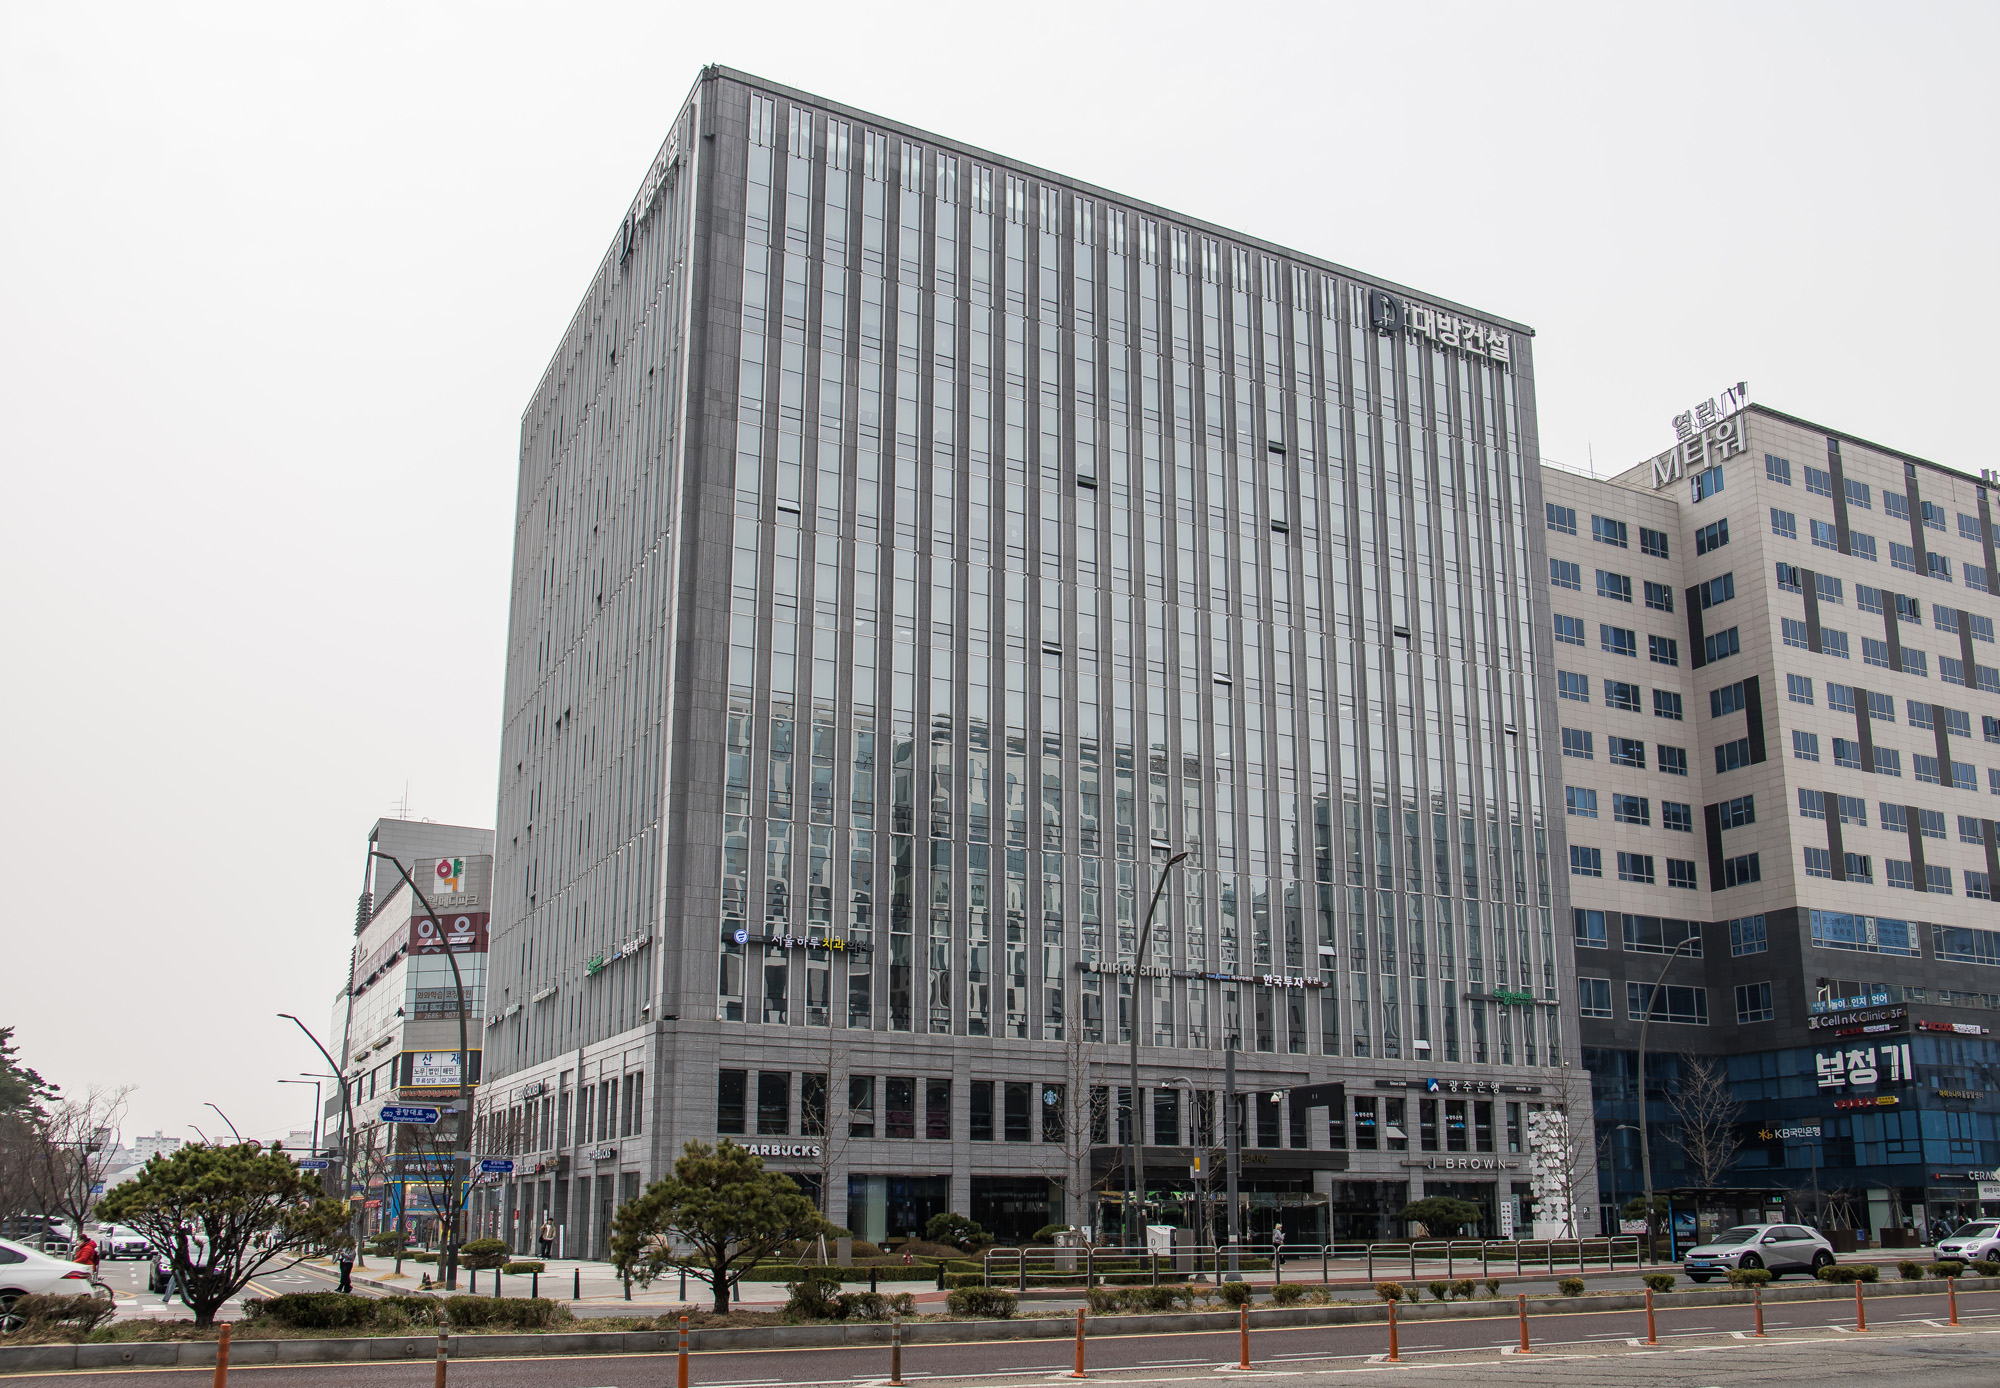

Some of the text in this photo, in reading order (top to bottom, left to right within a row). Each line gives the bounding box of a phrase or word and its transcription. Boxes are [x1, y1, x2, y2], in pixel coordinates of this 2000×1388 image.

[1410, 306, 1511, 363] 대방건설
[1672, 397, 1716, 440] 열린
[1650, 412, 1748, 489] M타워
[436, 858, 464, 893] 약
[822, 937, 846, 952] 치과
[1100, 961, 1121, 974] AIR
[1262, 973, 1305, 989] 한국투자
[1306, 976, 1319, 985] 증권
[445, 989, 472, 999] 코칭원
[1493, 988, 1534, 1000] Schneider
[1851, 996, 1867, 1007] 인지
[1871, 993, 1888, 1005] 언어
[1821, 1014, 1841, 1027] Cell
[1859, 1011, 1887, 1023] Clinic
[1890, 1008, 1903, 1019] 3F
[422, 1053, 433, 1066] 산
[1815, 1043, 1913, 1088] 보청기
[413, 1067, 426, 1076] 노무
[428, 1067, 440, 1075] 법인
[1449, 1080, 1500, 1094] 광주은행
[395, 1108, 424, 1116] 공항대로
[1774, 1126, 1821, 1139] KB국민은행
[1427, 1157, 1437, 1170] J
[1445, 1158, 1507, 1170] BROWN
